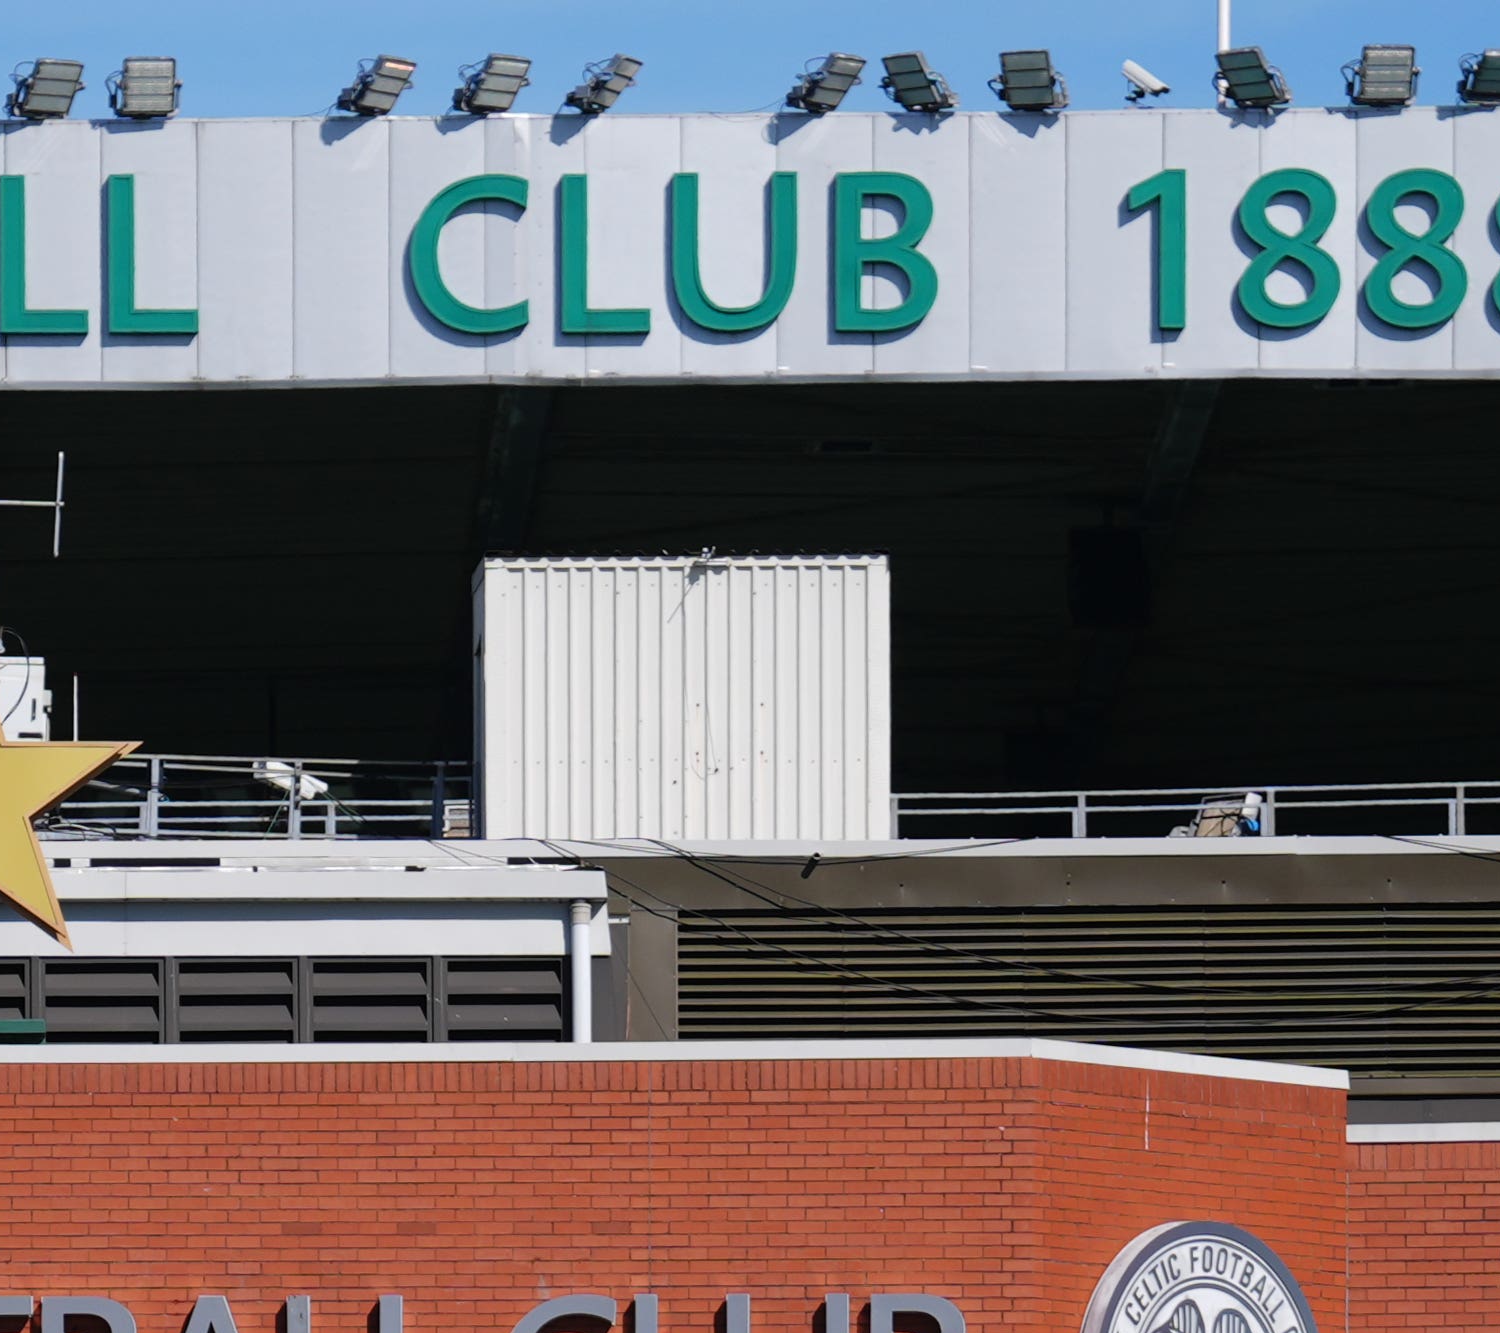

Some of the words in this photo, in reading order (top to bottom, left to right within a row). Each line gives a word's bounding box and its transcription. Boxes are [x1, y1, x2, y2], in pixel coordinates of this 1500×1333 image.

[410, 171, 940, 336] CLUB
[1125, 1253, 1181, 1325] CELTIC
[1188, 1245, 1285, 1324] FOOTBALL
